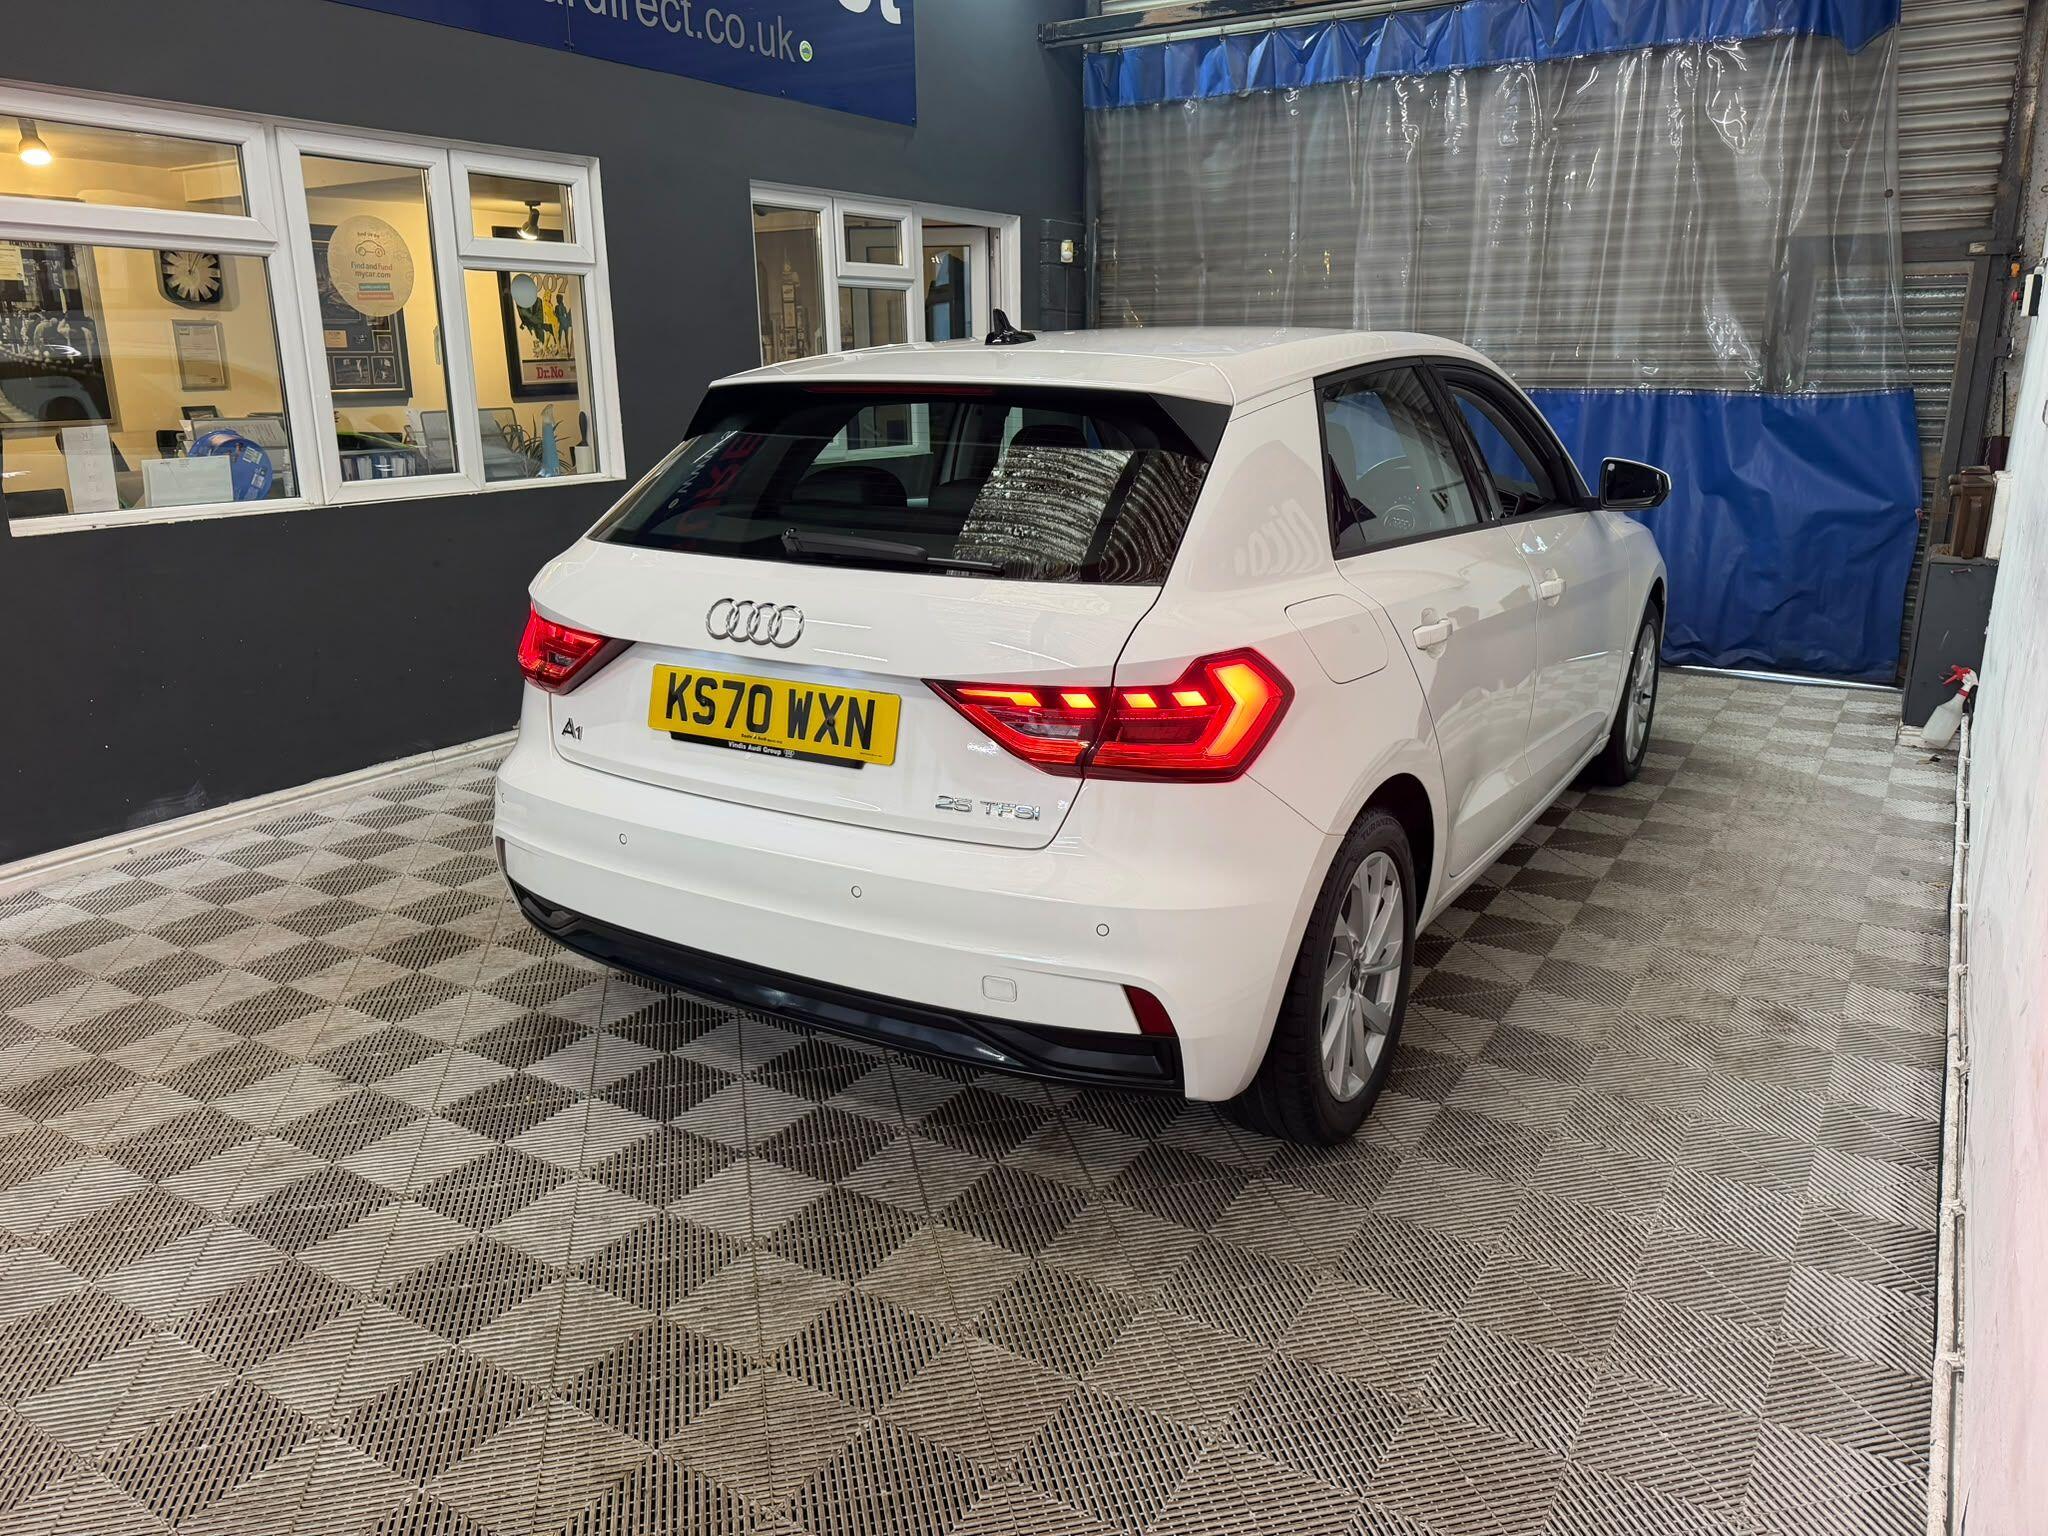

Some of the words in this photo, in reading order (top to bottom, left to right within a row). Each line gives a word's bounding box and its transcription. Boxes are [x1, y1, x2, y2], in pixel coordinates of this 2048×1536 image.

[665, 672, 774, 734] KS70
[788, 688, 876, 750] WXN
[561, 717, 583, 740] A1
[728, 741, 746, 750] Vindis
[747, 744, 762, 752] Audi
[763, 747, 781, 756] Group
[935, 795, 973, 813] 25
[980, 800, 1041, 821] TFSI
